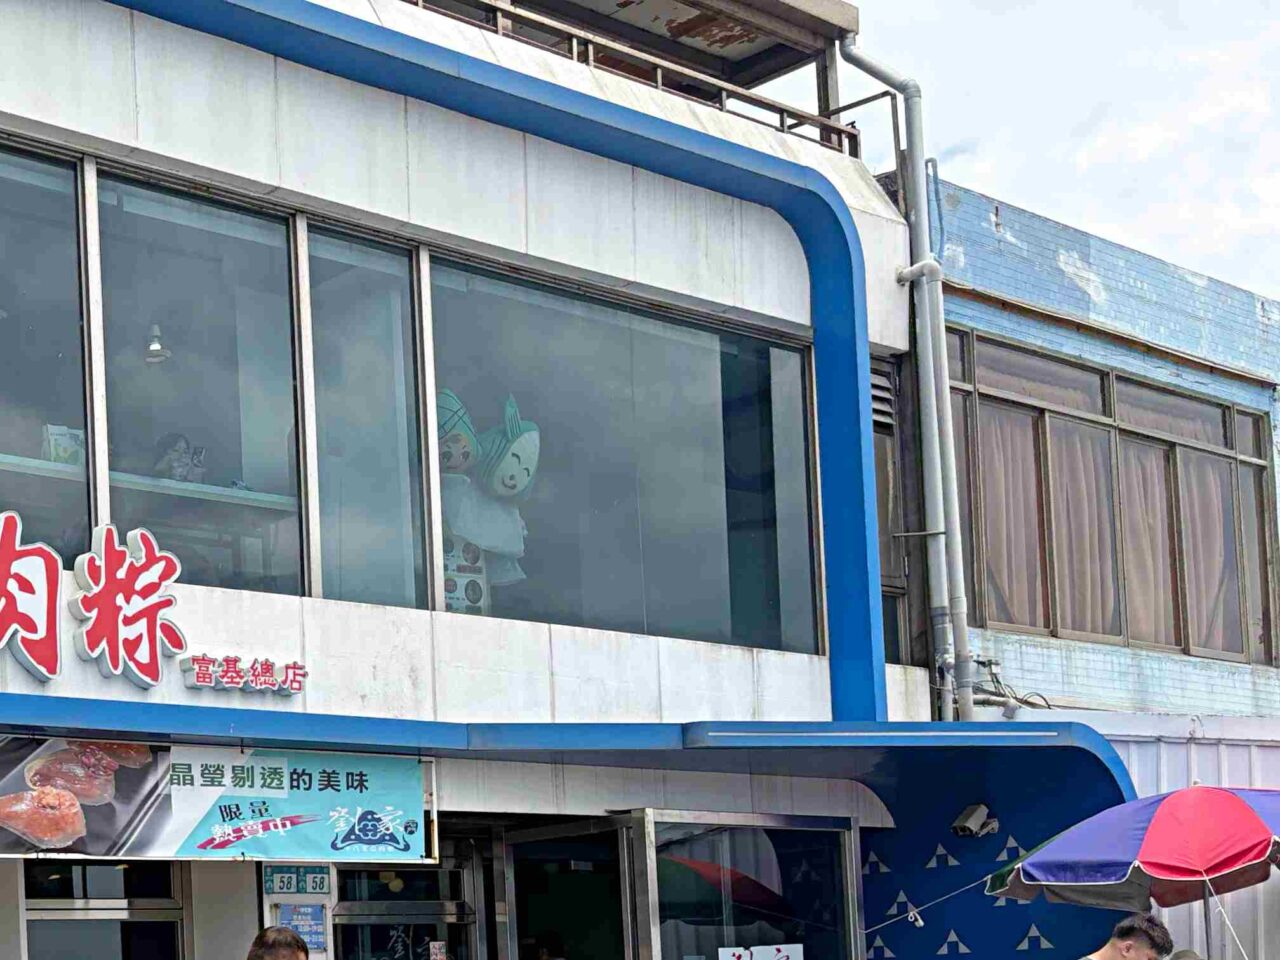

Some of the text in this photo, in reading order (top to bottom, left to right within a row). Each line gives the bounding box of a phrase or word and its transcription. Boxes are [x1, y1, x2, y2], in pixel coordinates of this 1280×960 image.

[191, 653, 308, 692] 富基總店
[169, 763, 369, 793] 晶瑩剔透的美味
[218, 801, 272, 822] 限量
[279, 876, 293, 891] 58
[311, 876, 325, 891] 58
